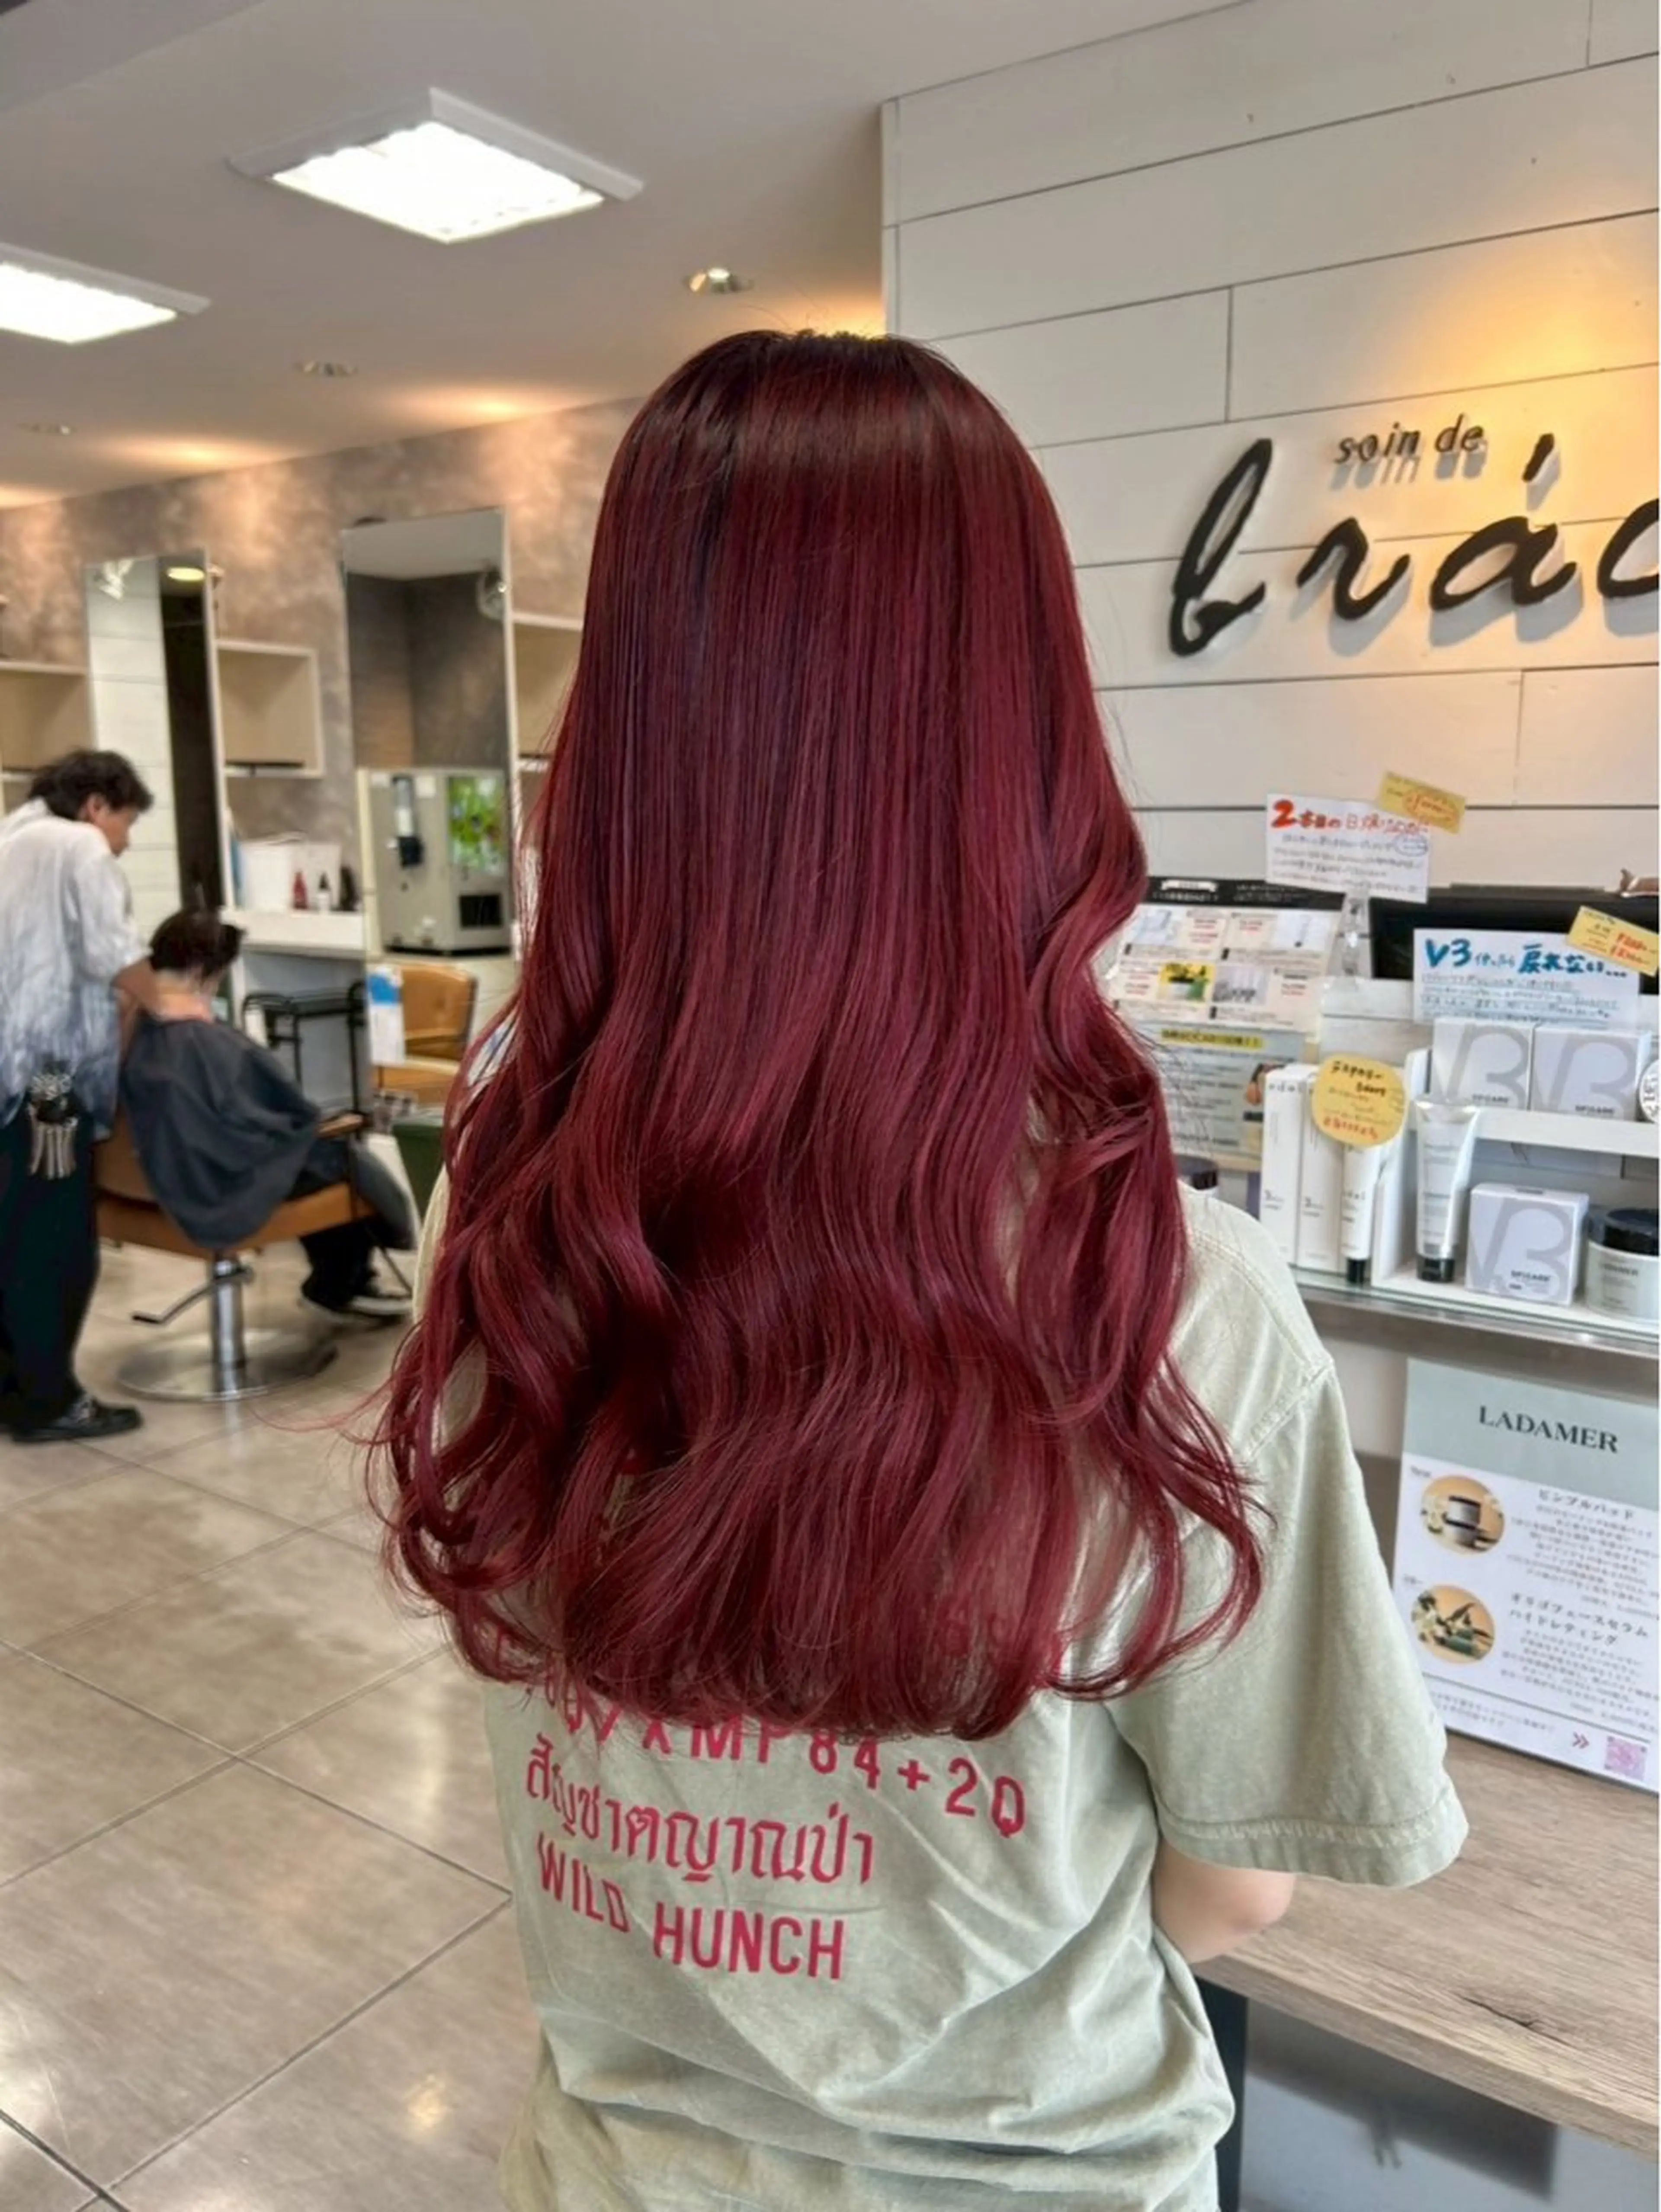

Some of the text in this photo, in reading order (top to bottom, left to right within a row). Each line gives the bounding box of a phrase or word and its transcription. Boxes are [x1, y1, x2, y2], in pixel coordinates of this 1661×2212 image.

[1334, 413, 1485, 464] soin de
[1478, 1405, 1619, 1454] LADAMER
[537, 1832, 844, 1981] WILD HUNCH
